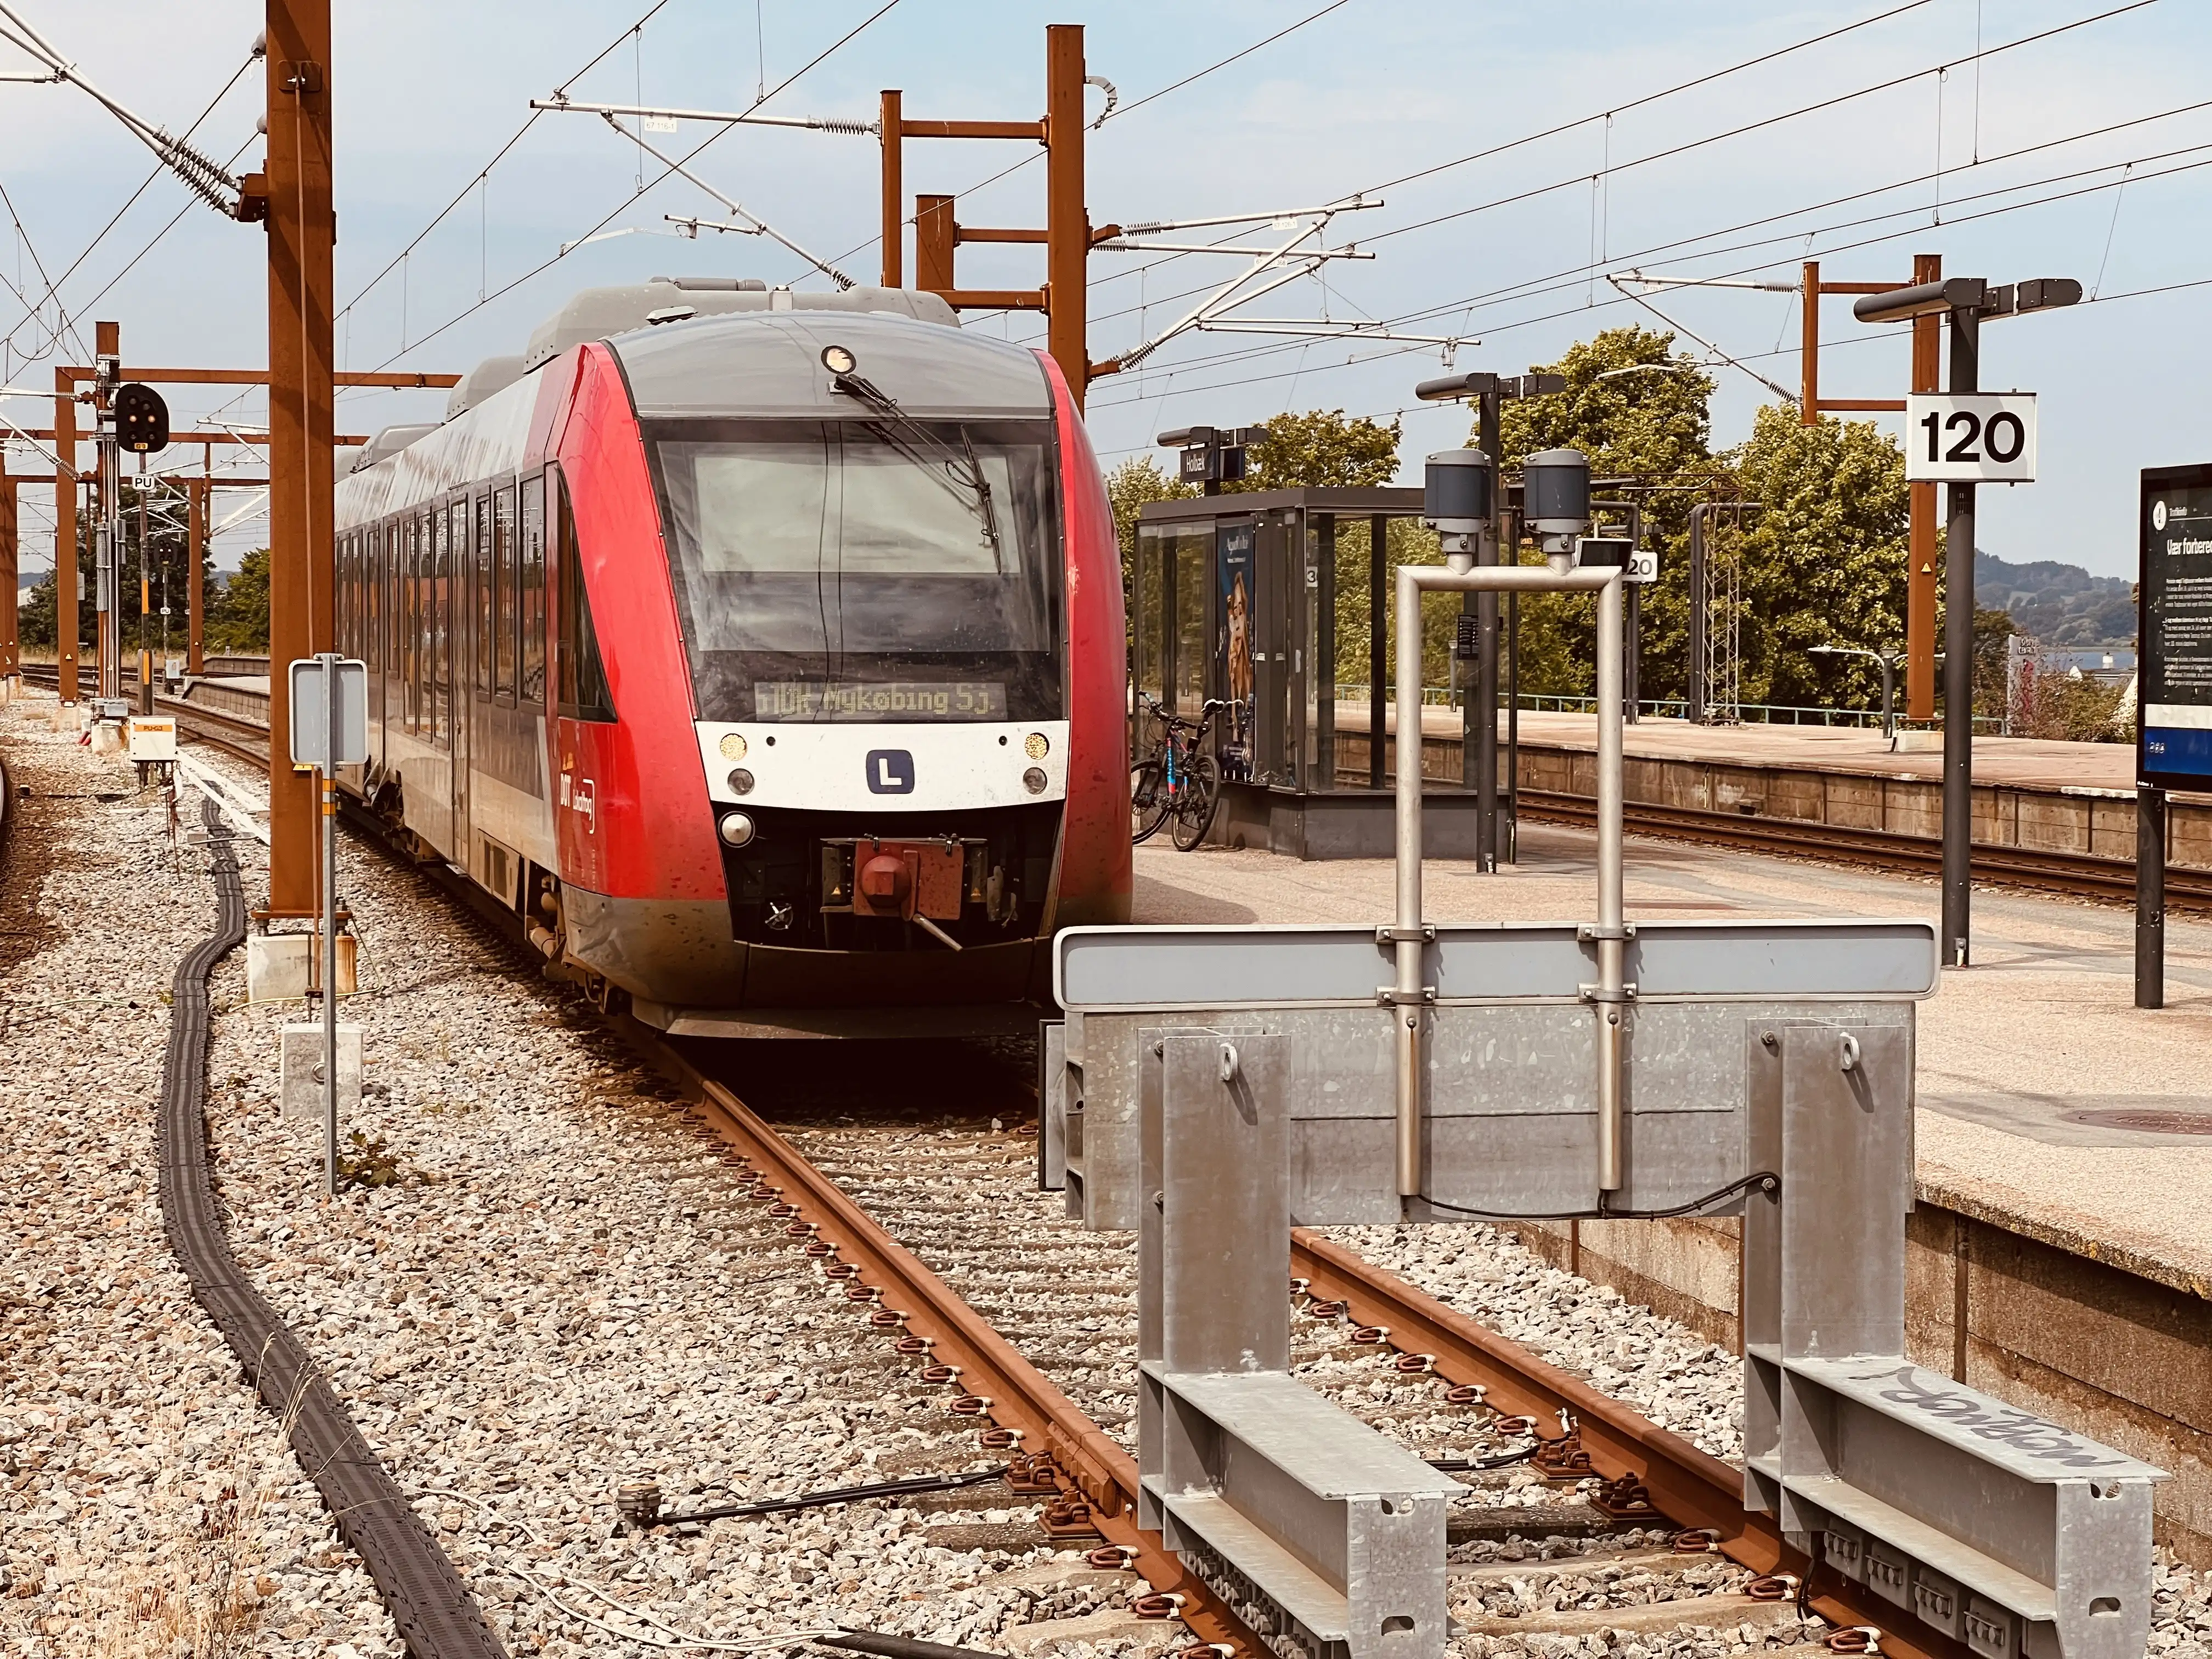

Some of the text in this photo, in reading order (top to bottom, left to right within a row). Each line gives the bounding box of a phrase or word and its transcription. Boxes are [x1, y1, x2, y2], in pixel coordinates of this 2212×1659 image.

[1921, 411, 2025, 464] 120
[135, 477, 151, 488] PU
[1624, 558, 1652, 575] 20
[1307, 570, 1318, 583] 3
[878, 758, 902, 787] L
